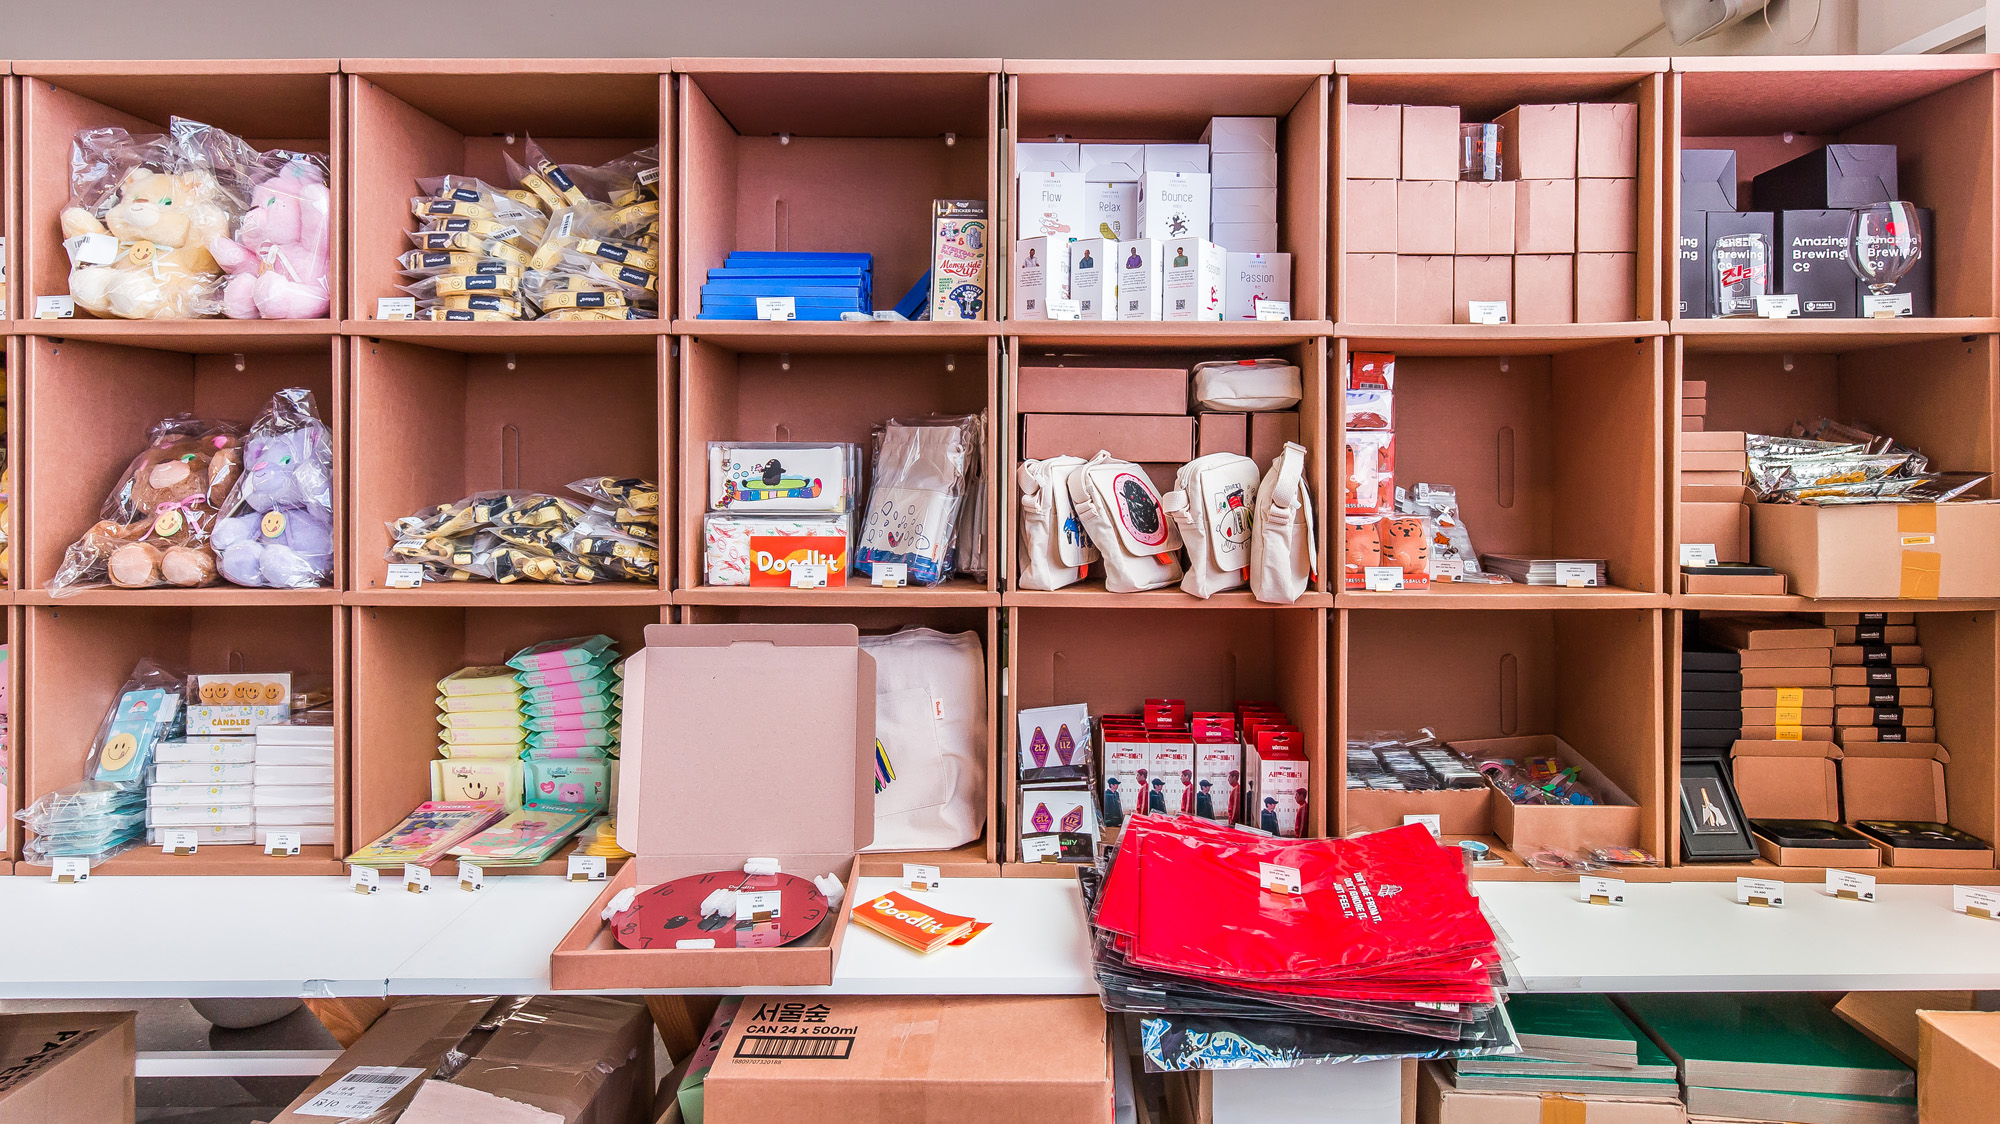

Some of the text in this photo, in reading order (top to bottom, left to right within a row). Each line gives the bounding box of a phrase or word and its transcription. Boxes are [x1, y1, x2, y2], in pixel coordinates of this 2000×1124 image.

[1042, 190, 1062, 202] Flow
[1162, 190, 1193, 202] Bounce
[1099, 202, 1120, 212] Relax
[1792, 235, 1848, 248] Amazing
[1717, 250, 1764, 260] Brewing
[1792, 249, 1849, 260] Brewing
[1240, 272, 1274, 282] Passion
[951, 286, 982, 298] STAY RICH
[212, 716, 250, 726] CANDLES
[452, 766, 473, 774] Knotted
[547, 767, 570, 775] Knotted
[1065, 816, 1079, 825] 211
[653, 885, 674, 896] 10
[808, 890, 817, 900] 2
[1338, 894, 1351, 911] FEEL
[1348, 890, 1366, 912] IGNORE
[1364, 896, 1380, 916] FROM
[803, 909, 820, 921] 3
[872, 899, 943, 934] Doodlit
[752, 1003, 831, 1022] 서울숲
[746, 1025, 778, 1034] CAN
[780, 1026, 798, 1034] 24
[812, 1026, 858, 1035] 500ml
